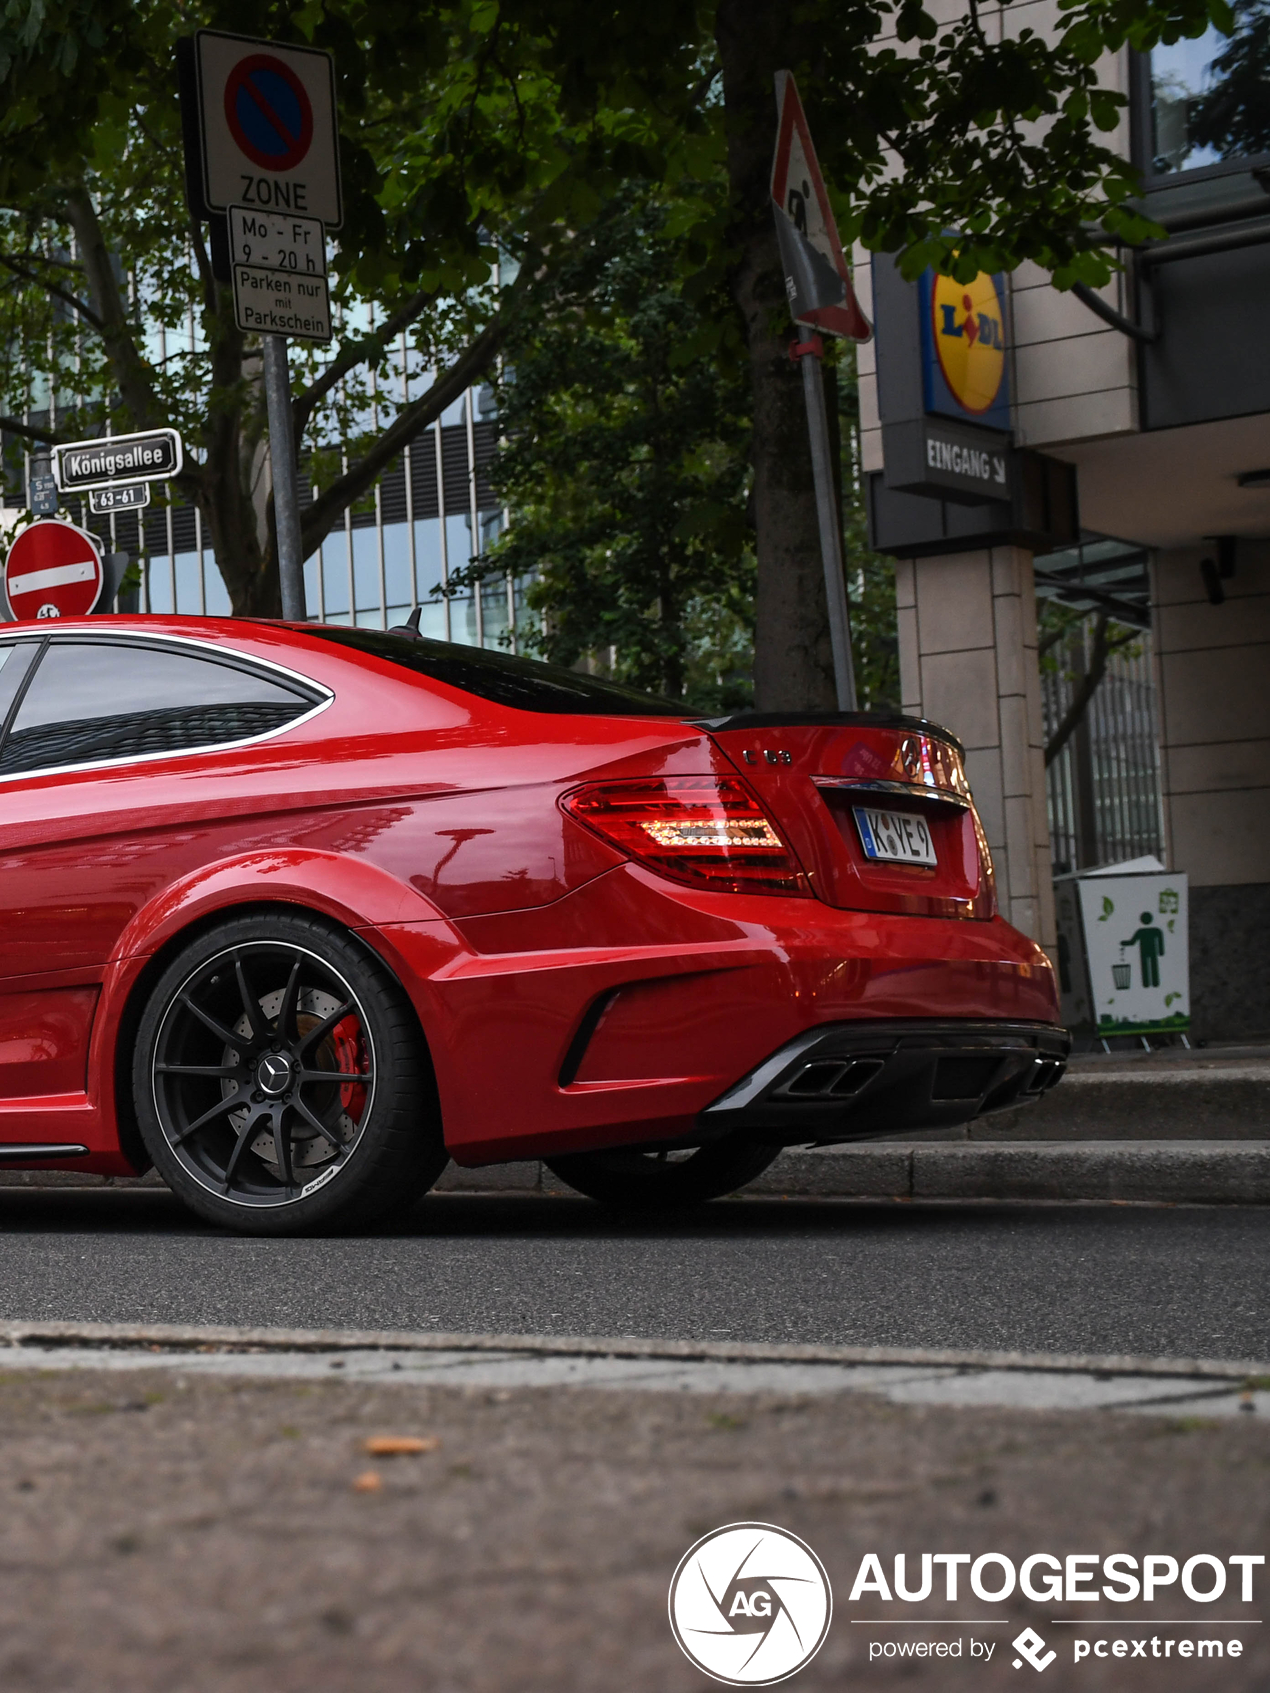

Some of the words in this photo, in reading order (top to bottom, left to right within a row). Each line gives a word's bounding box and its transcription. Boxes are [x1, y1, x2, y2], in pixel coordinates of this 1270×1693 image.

[241, 175, 308, 211] ZONE
[242, 216, 268, 238] Mo
[292, 224, 311, 245] Fr
[242, 244, 252, 263] 9
[278, 249, 298, 270] 20
[306, 253, 316, 272] h
[240, 271, 292, 294] Parken
[297, 278, 321, 298] nur
[275, 298, 292, 309] mit
[244, 307, 324, 333] Parkschein
[71, 446, 164, 477] Königsallee
[927, 438, 989, 481] EINGANG
[742, 750, 758, 764] C
[763, 750, 792, 764] 63
[867, 814, 888, 853] K
[890, 816, 920, 857] YE
